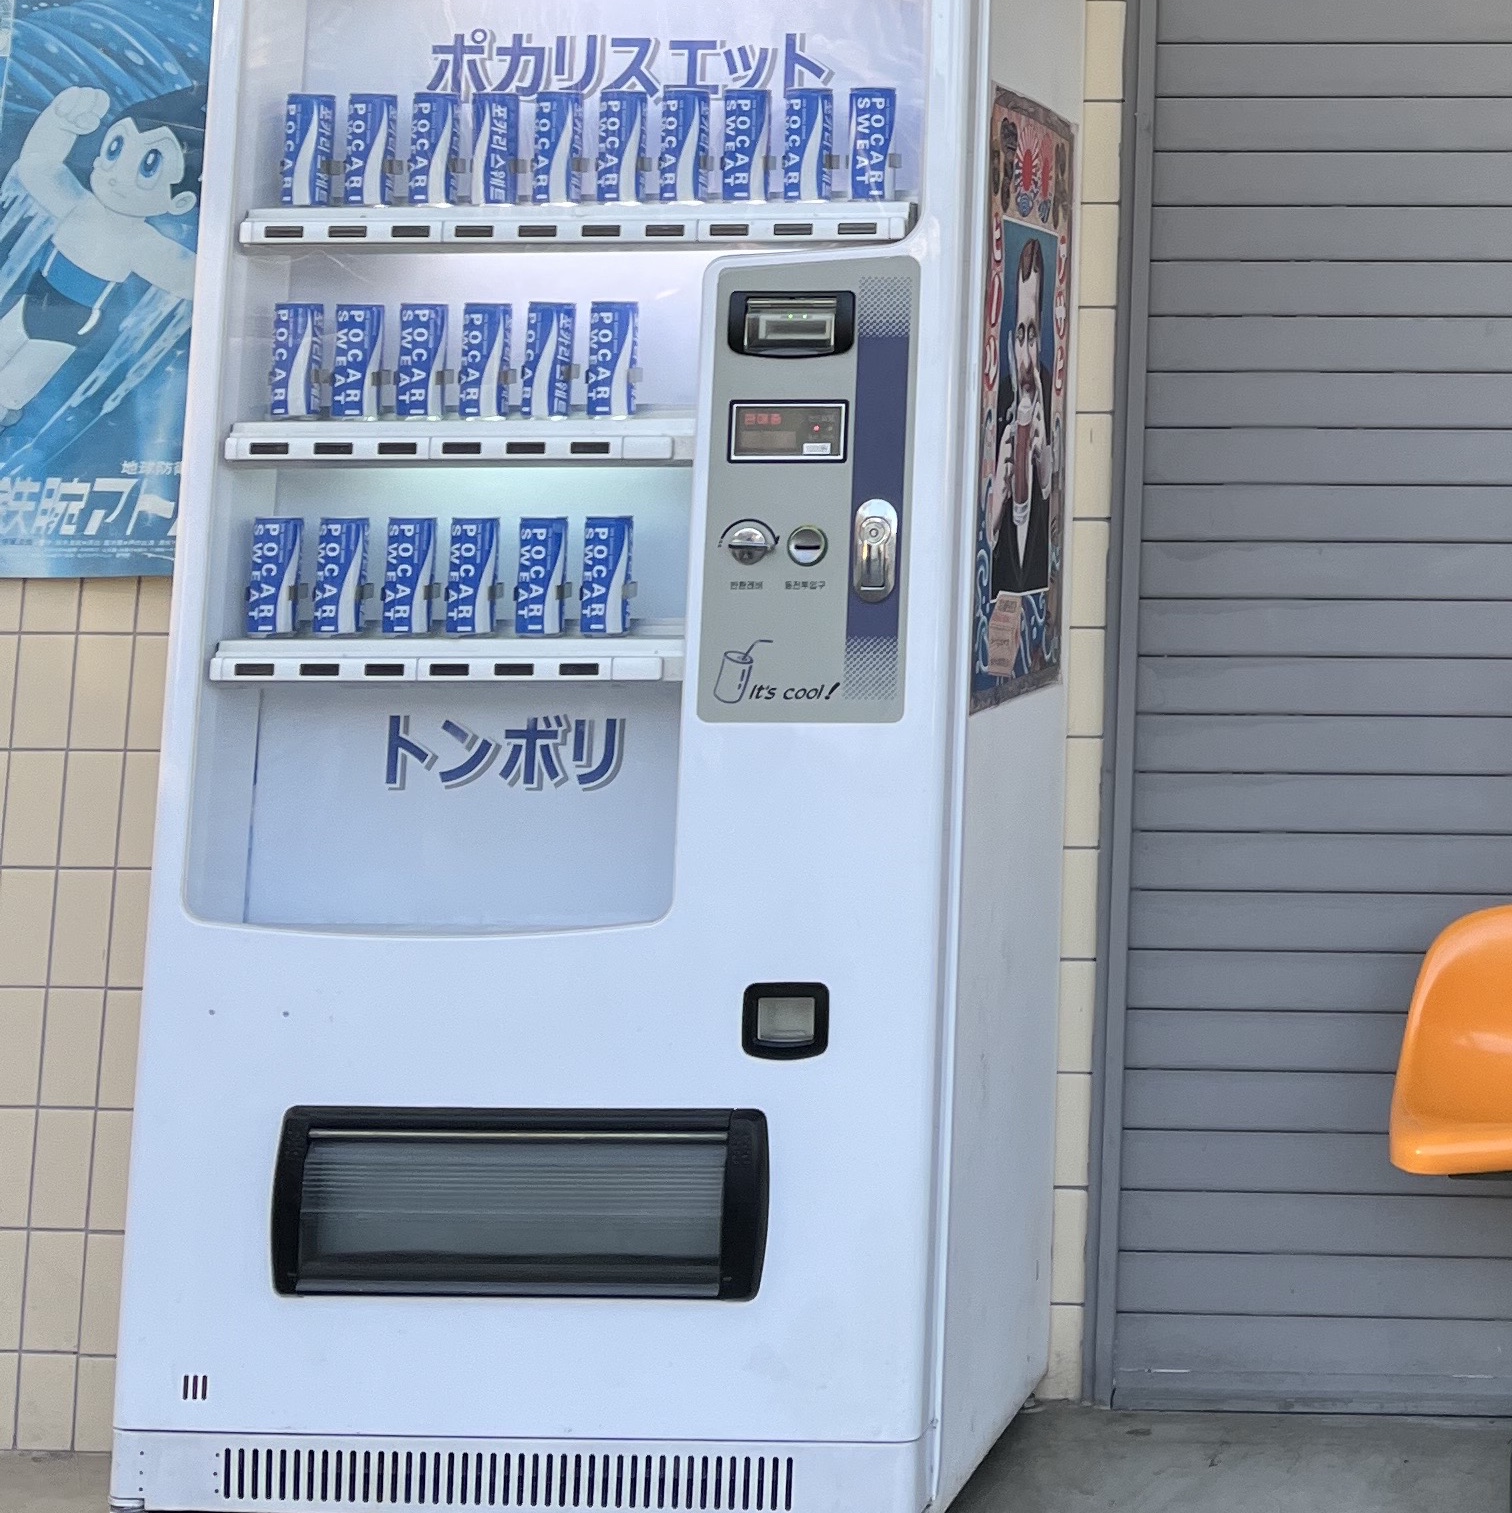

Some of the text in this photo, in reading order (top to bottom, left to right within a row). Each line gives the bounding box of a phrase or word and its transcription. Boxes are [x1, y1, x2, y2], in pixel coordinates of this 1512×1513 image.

[427, 28, 834, 102] ポカリスエット
[348, 103, 367, 201] POCARI
[413, 102, 431, 200] POCARI
[534, 101, 550, 199] POCARI
[604, 100, 620, 198] POCARI
[663, 99, 678, 198] POCARI
[724, 99, 737, 186] SWEAT
[734, 99, 751, 198] POCARI
[786, 98, 801, 197] POCARI
[856, 96, 871, 184] SWEAT
[868, 97, 885, 196] POCARI
[272, 309, 288, 414] POCARI
[333, 310, 349, 405] SWEAT
[344, 310, 364, 415] POCARI
[398, 309, 413, 404] SWEAT
[409, 309, 429, 415] POCARI
[465, 313, 483, 413] POCARI
[595, 311, 613, 412] POCARI
[0, 477, 179, 536] 鉄腕アト
[248, 524, 264, 621] SWEAT
[257, 524, 280, 631] POCARI
[320, 524, 341, 631] POCARI
[384, 525, 399, 621] SWEAT
[393, 524, 414, 632] POCARI
[447, 525, 461, 621] SWEAT
[456, 524, 477, 632] POCARI
[517, 528, 532, 619] SWEAT
[527, 528, 547, 631] POCARI
[589, 527, 608, 630] POCARI
[749, 684, 776, 700] It's
[385, 714, 626, 791] トンボリ
